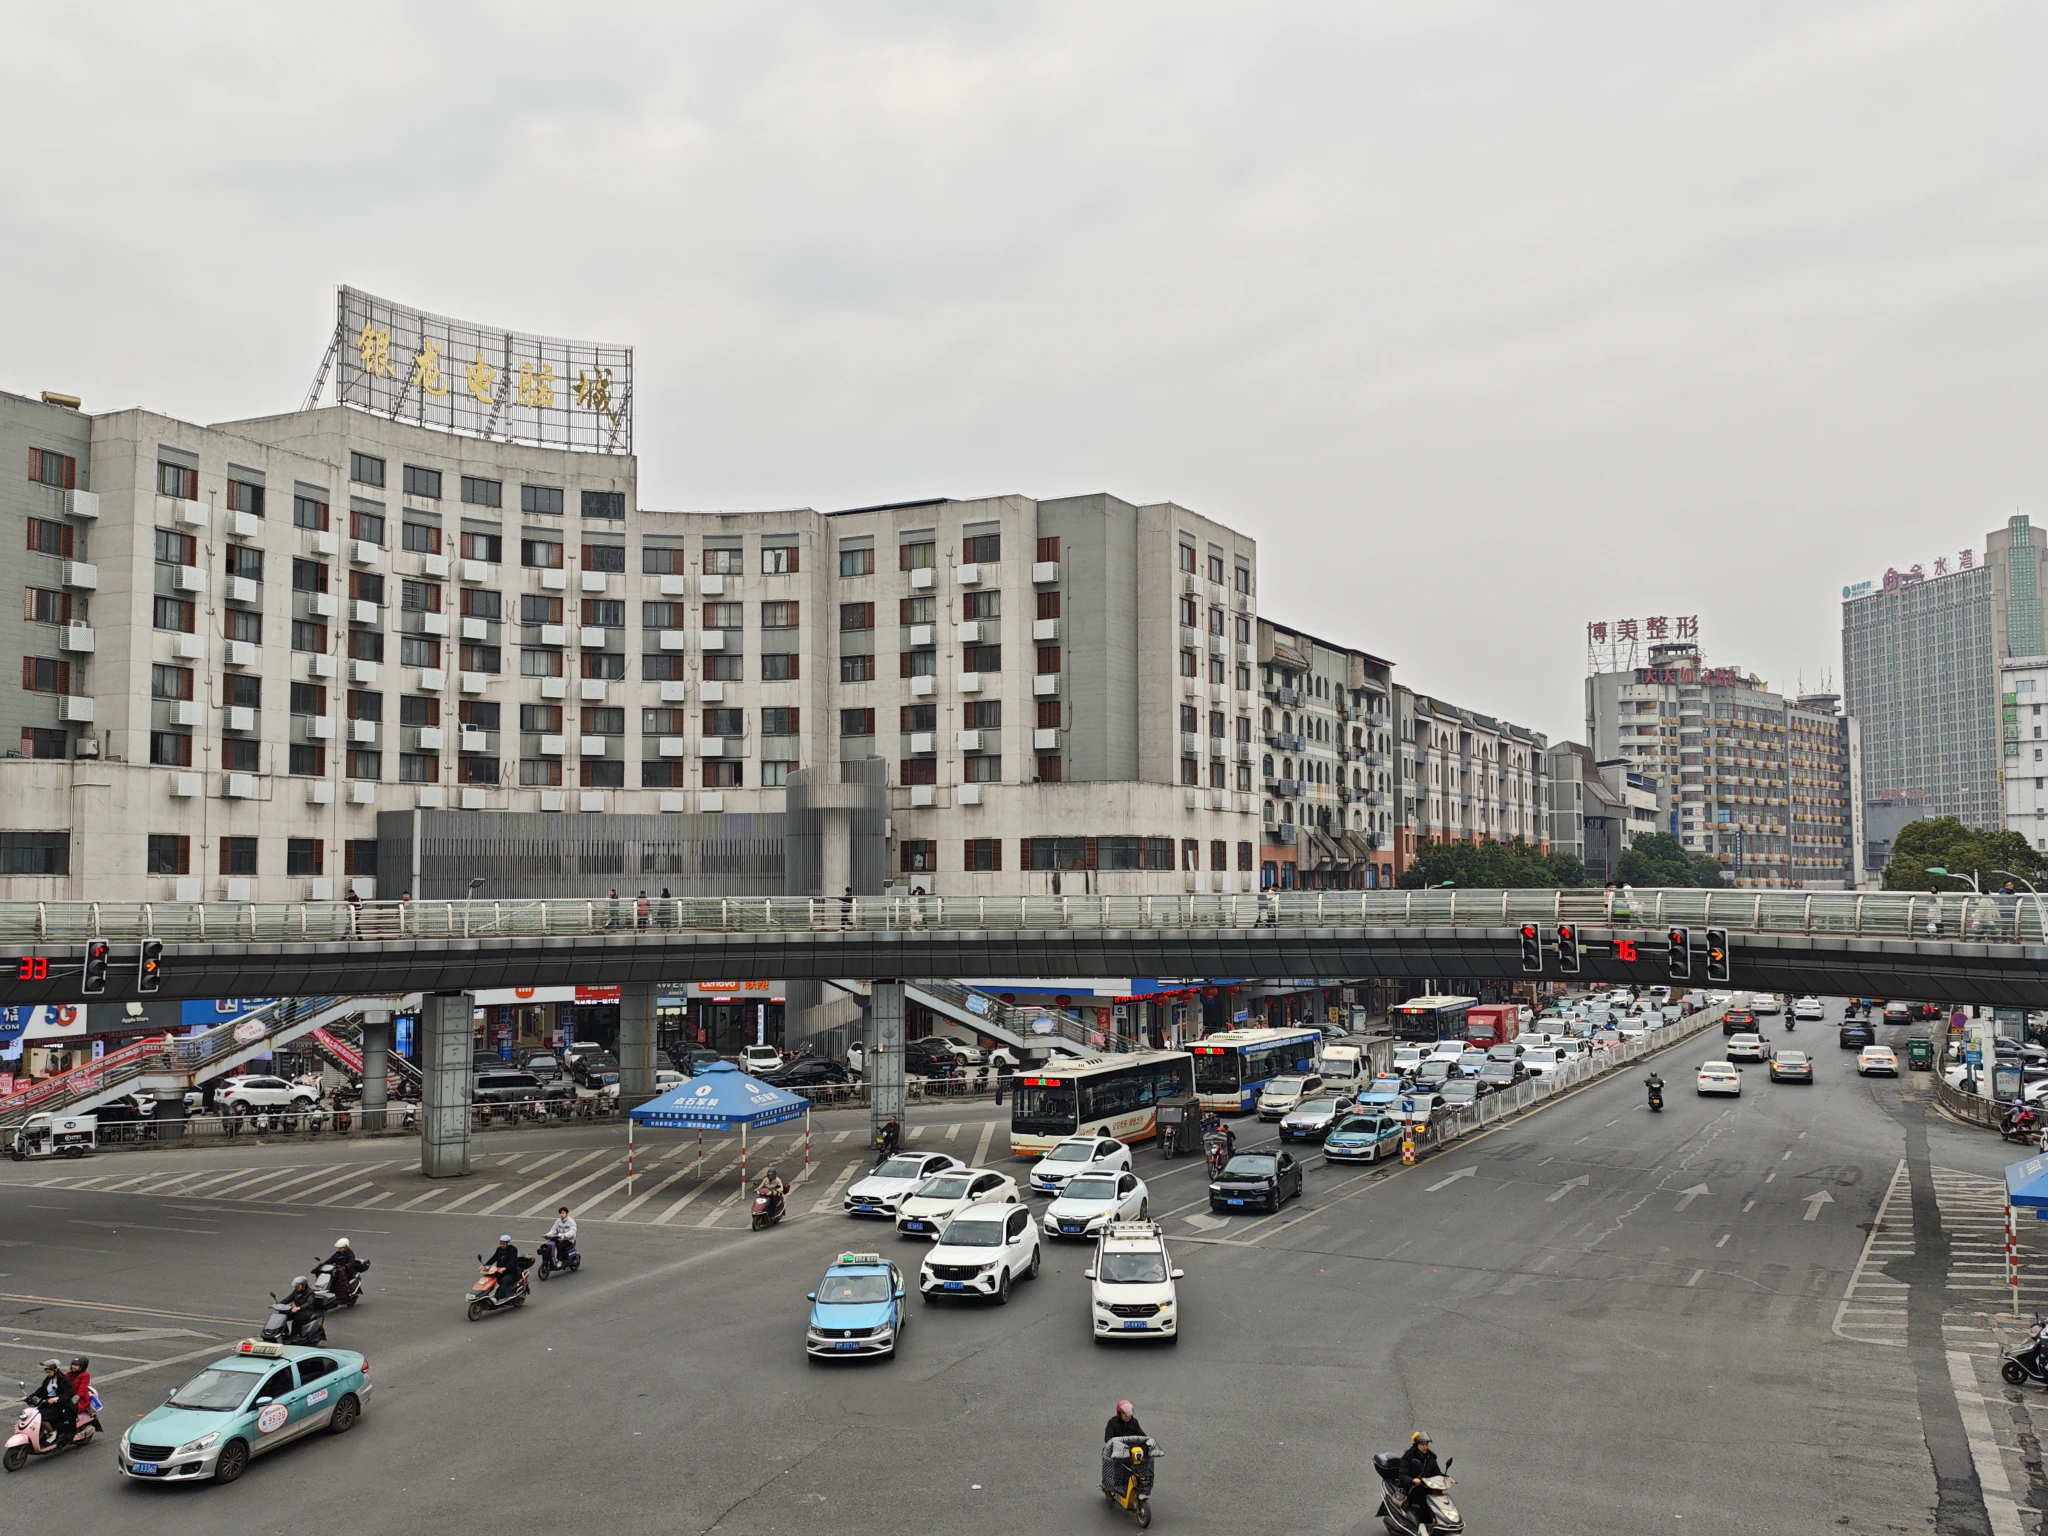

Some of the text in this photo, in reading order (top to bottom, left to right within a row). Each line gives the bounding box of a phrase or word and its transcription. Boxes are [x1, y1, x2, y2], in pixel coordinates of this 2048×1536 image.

[356, 320, 618, 423] 银龙电脑城
[1910, 549, 1973, 584] 金水湾
[1587, 615, 1699, 644] 博美整形
[20, 957, 47, 980] 33
[44, 1004, 77, 1027] 5G
